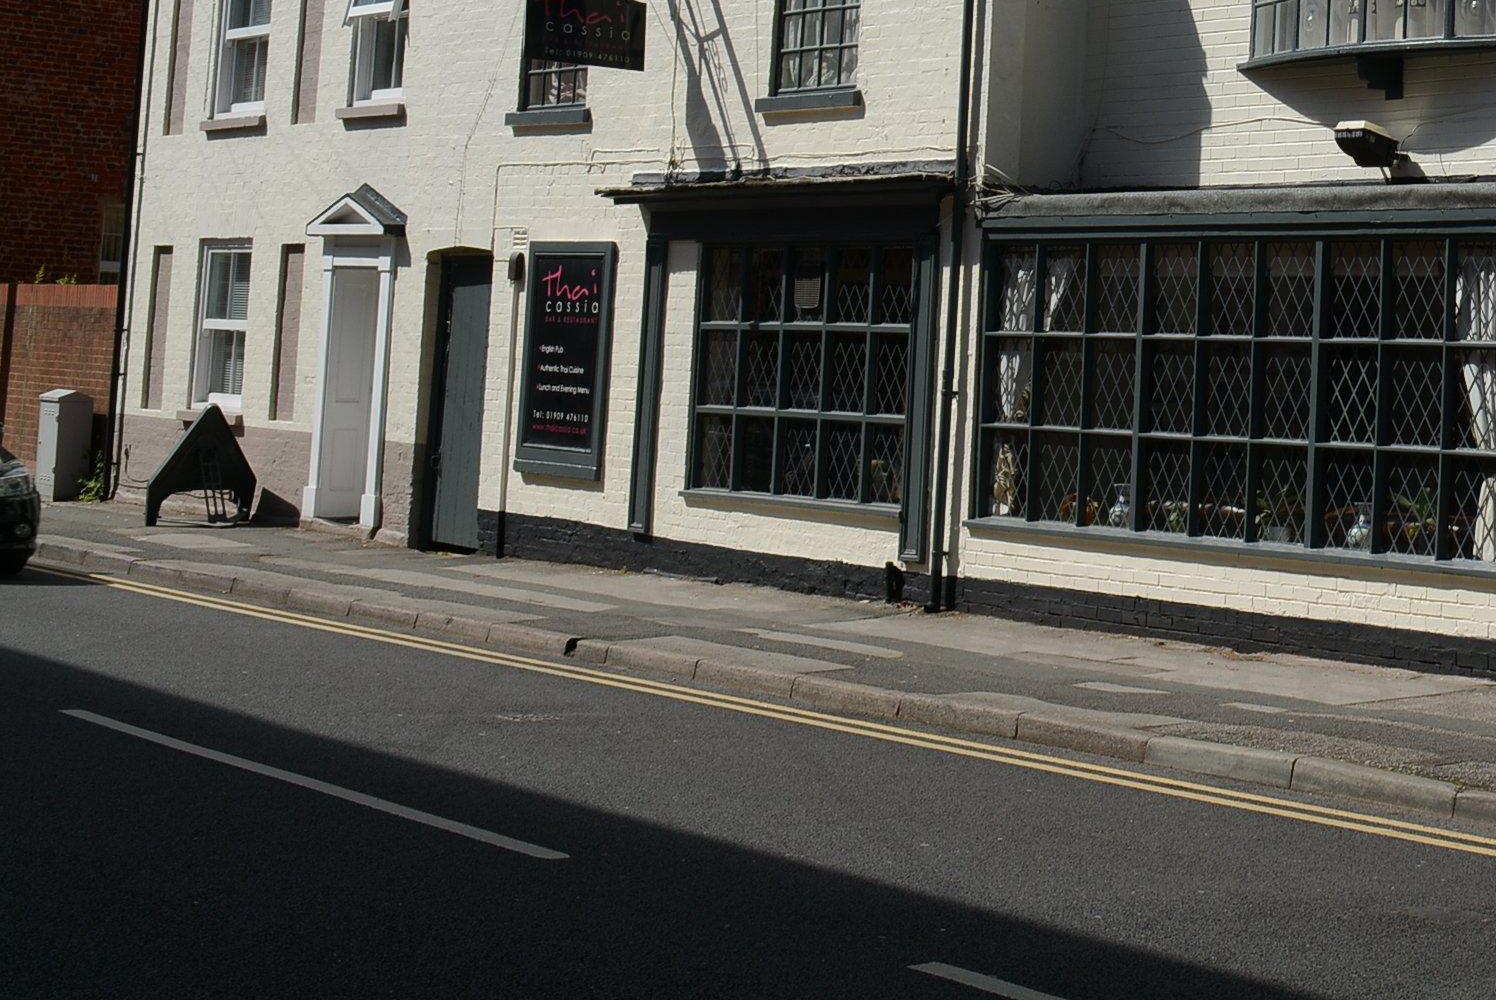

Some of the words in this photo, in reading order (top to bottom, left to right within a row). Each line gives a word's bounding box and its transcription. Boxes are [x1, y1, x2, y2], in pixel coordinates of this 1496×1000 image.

[545, 21, 631, 41] cassia
[566, 49, 593, 59] 01909
[598, 53, 631, 64] 476110
[545, 300, 599, 314] cassia
[541, 344, 555, 355] English
[555, 345, 564, 354] Pub
[540, 364, 559, 373] Authentic
[560, 365, 568, 374] Thai
[569, 366, 584, 375] Cuisine
[538, 383, 552, 392] Lunch
[552, 384, 560, 392] and
[560, 385, 577, 395] Evening
[577, 387, 590, 395] Menu
[533, 409, 544, 419] Tel:
[546, 411, 564, 421] 01909
[566, 413, 589, 423] 476110
